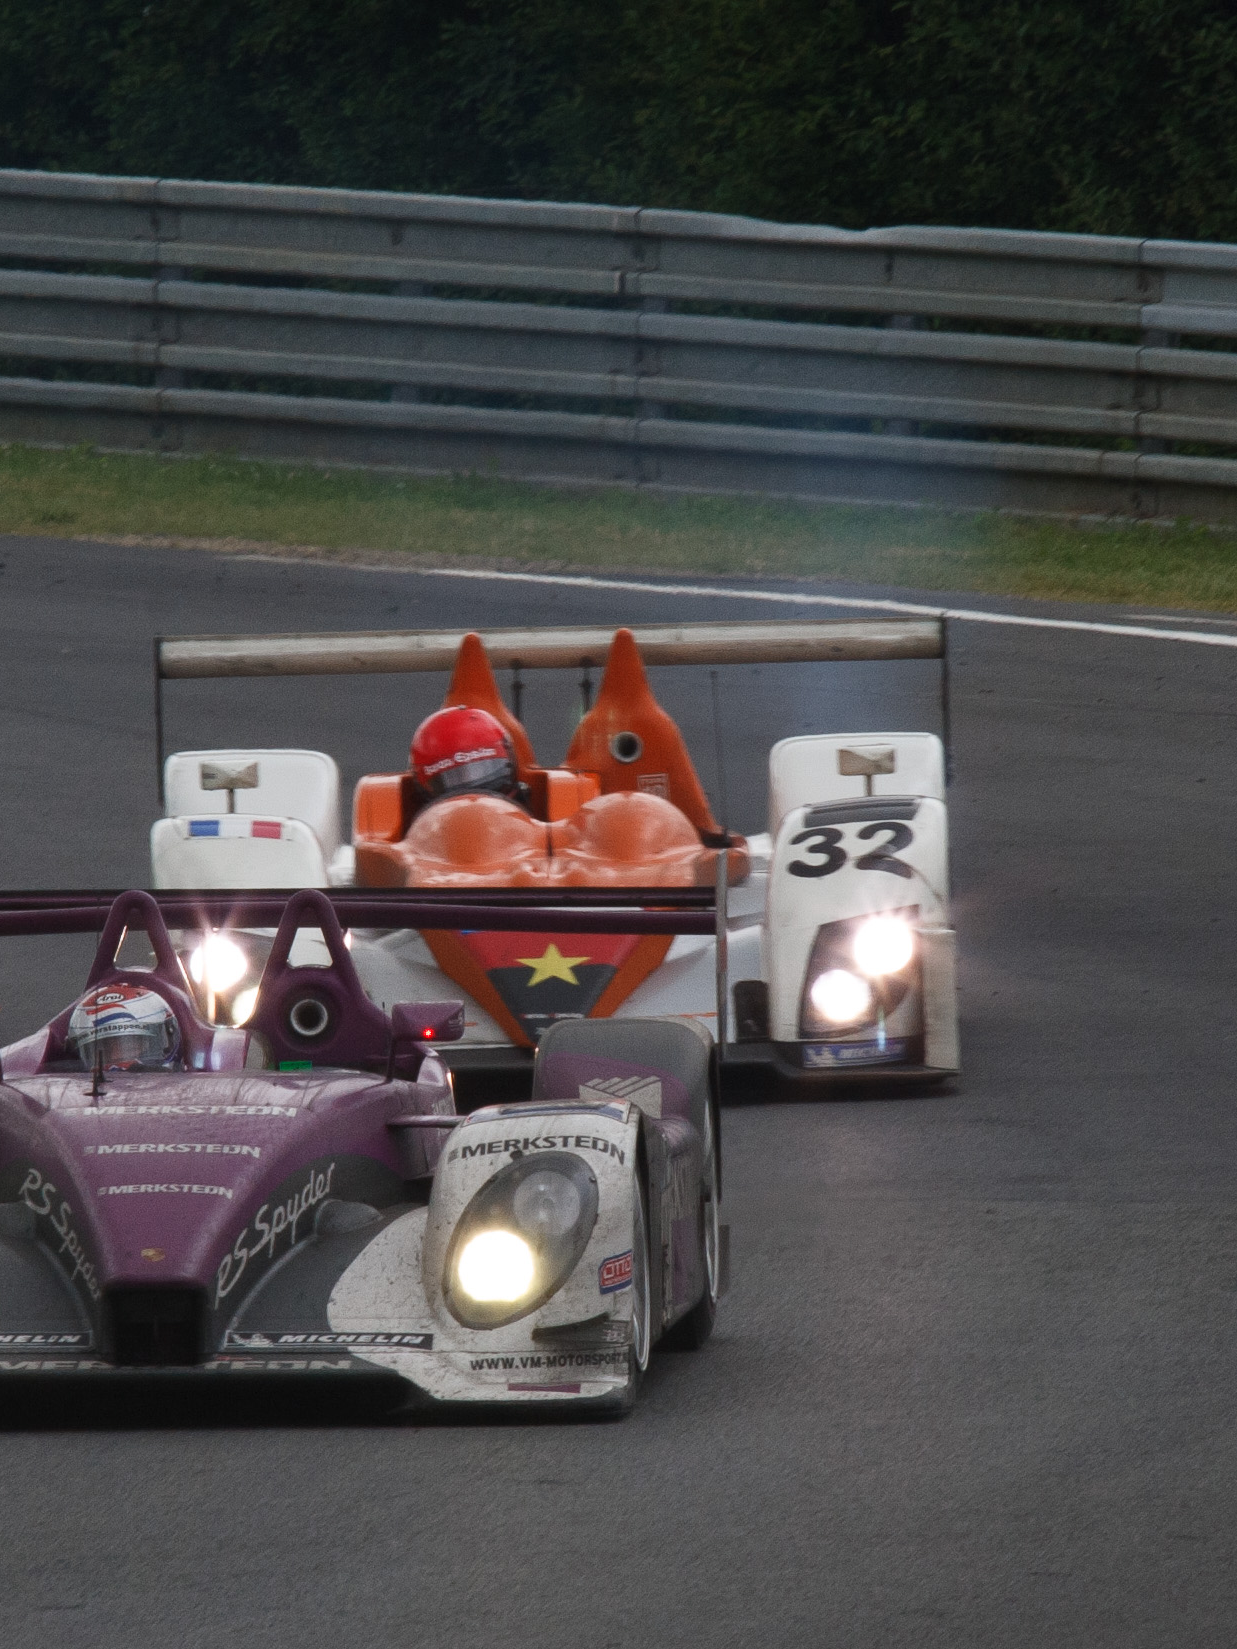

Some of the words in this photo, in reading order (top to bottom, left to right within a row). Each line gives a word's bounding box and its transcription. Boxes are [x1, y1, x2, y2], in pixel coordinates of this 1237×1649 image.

[787, 821, 914, 879] 32
[214, 1227, 249, 1311] RS
[248, 1162, 336, 1259] Spyder
[277, 1334, 426, 1344] MICHELIN
